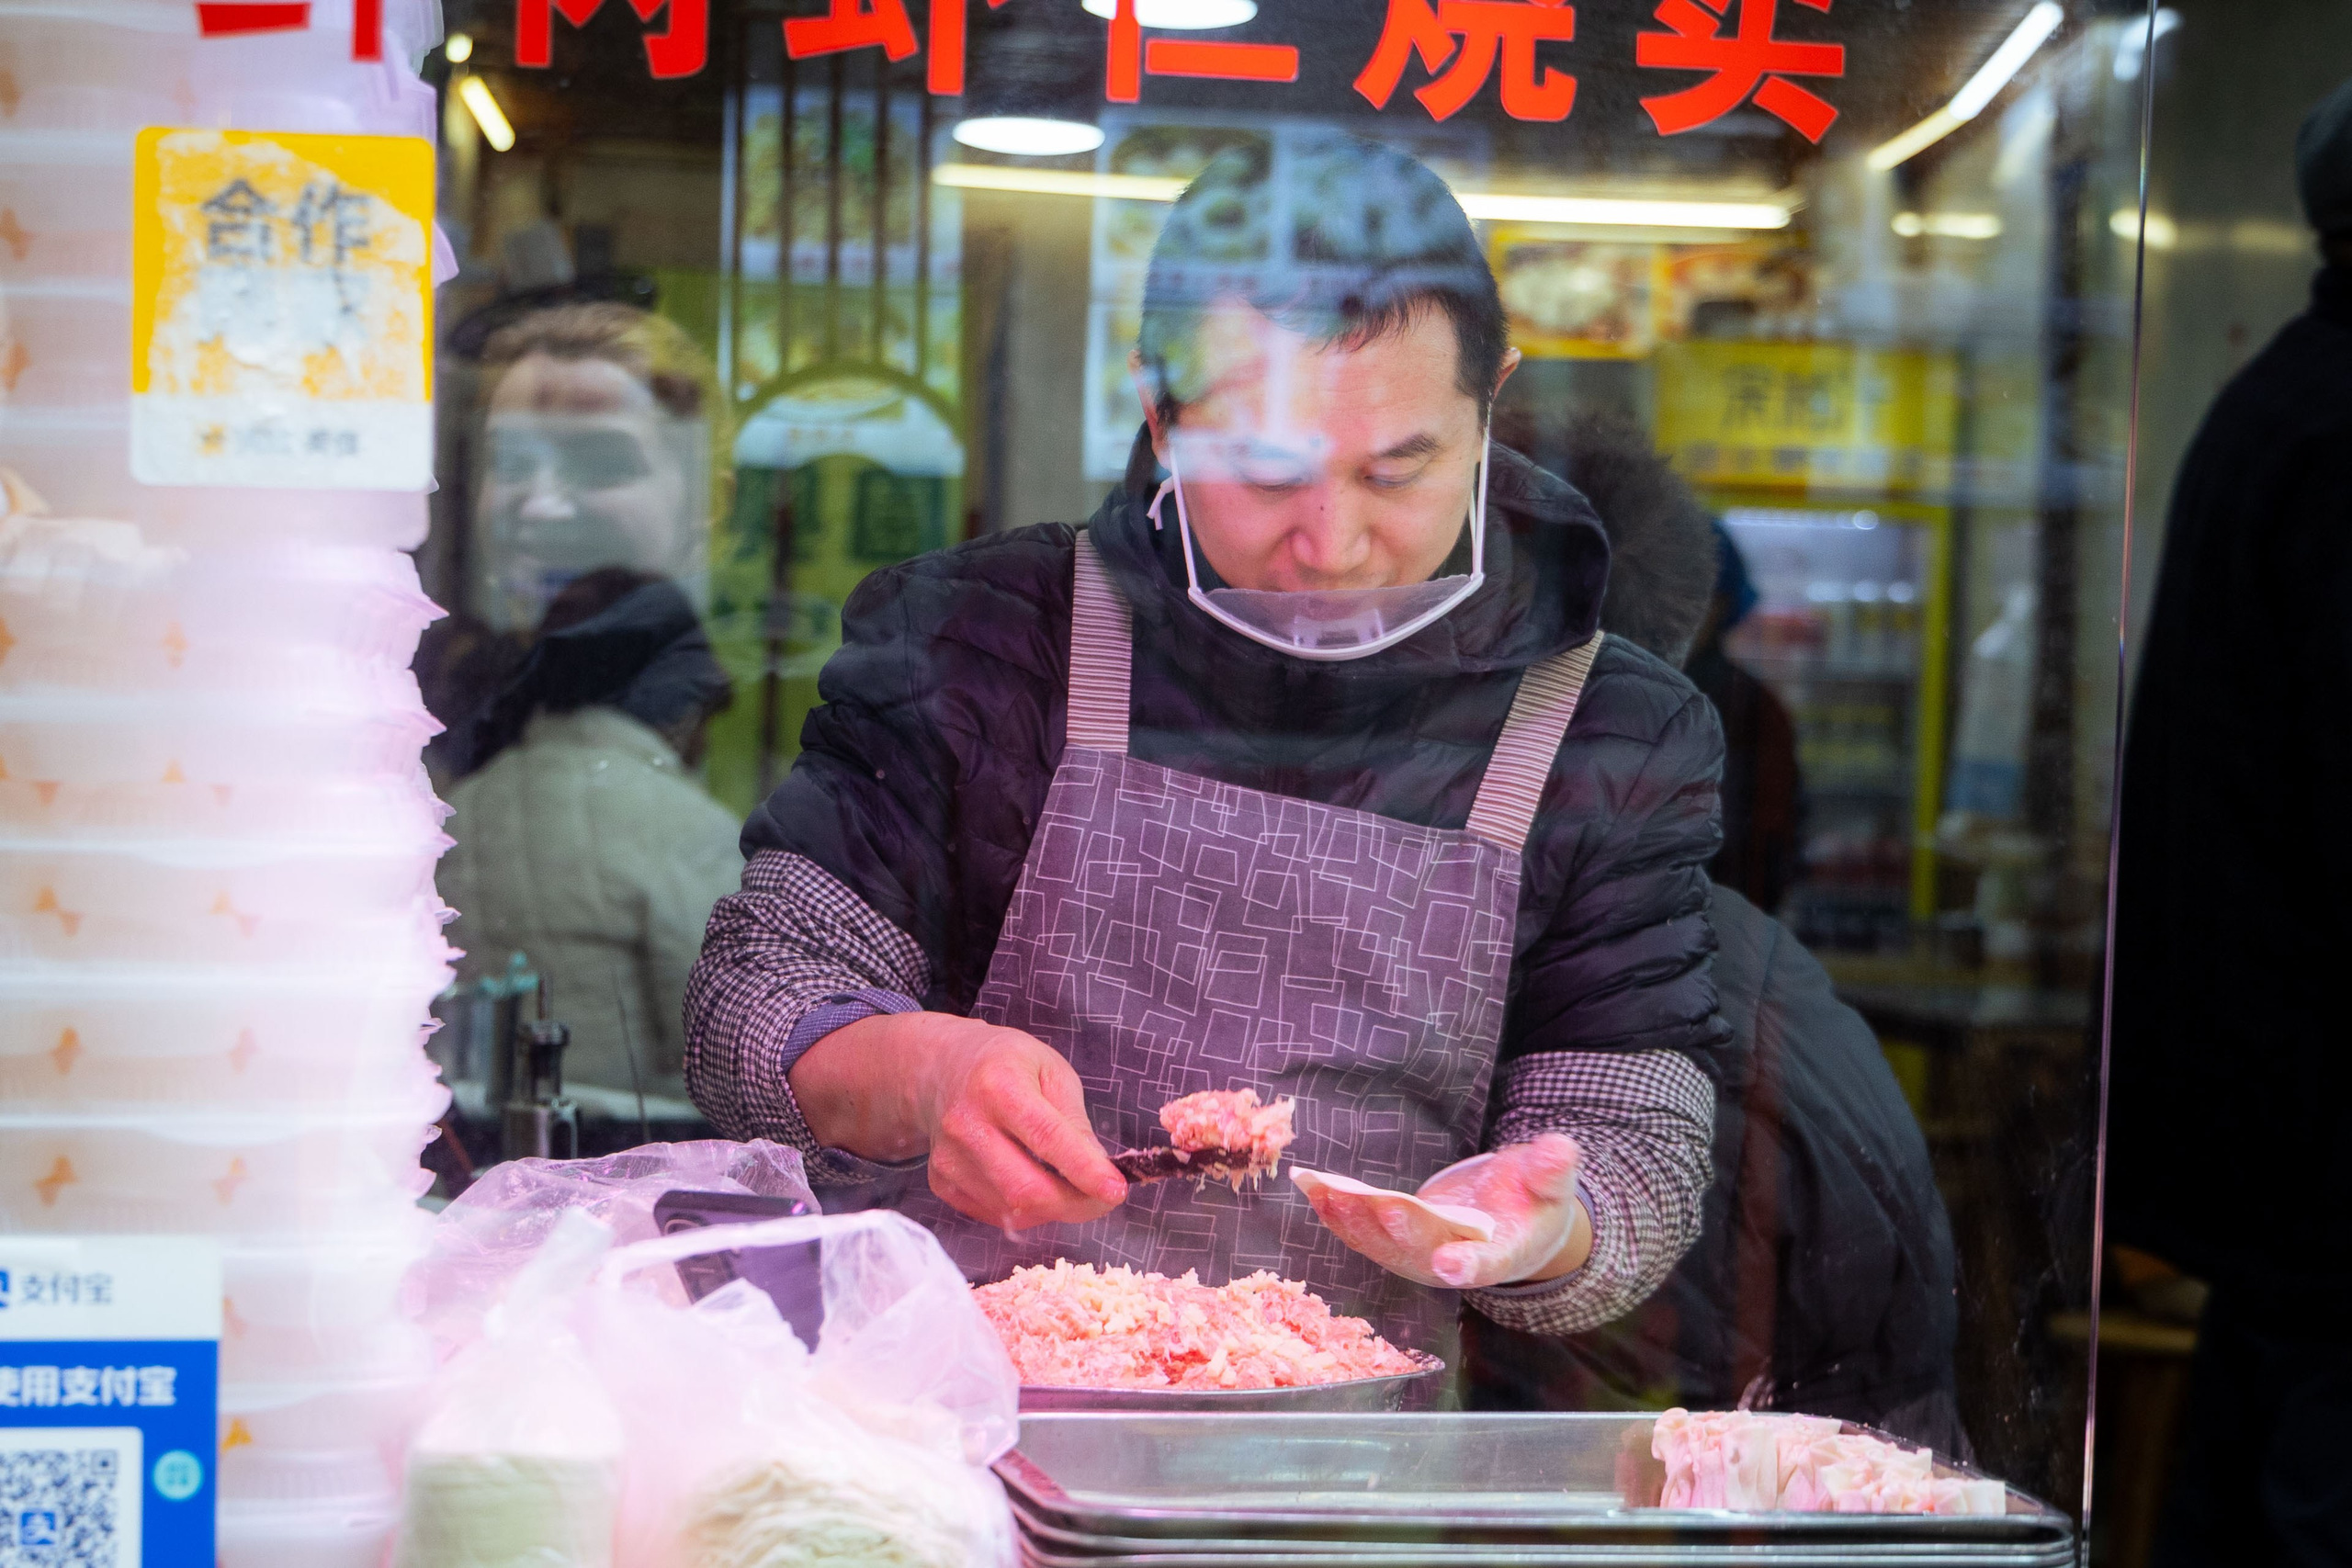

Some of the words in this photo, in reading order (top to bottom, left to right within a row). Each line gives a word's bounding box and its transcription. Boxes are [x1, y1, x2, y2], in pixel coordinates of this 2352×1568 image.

[202, 178, 372, 264] 合作
[20, 1271, 114, 1306] 支付宝
